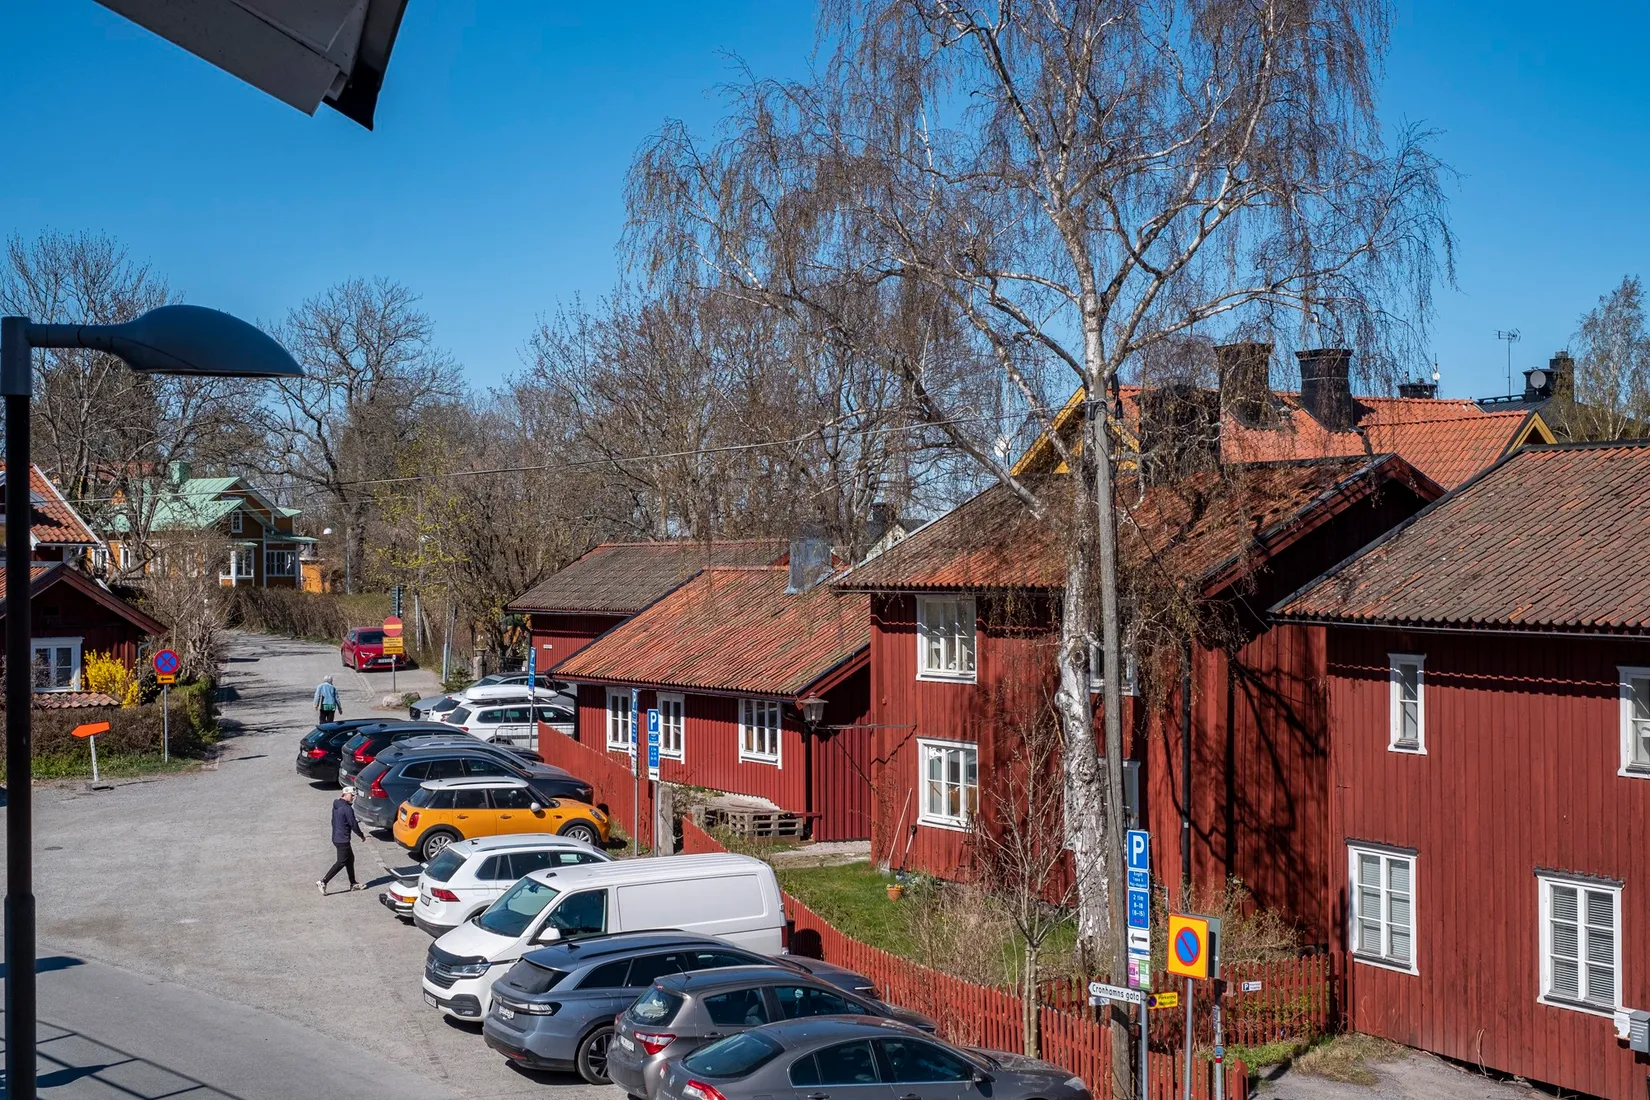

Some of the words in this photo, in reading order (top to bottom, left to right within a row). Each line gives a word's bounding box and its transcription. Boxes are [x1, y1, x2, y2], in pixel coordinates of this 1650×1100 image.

[650, 711, 657, 731] P
[1133, 835, 1145, 866] P
[1092, 984, 1124, 999] Cronhamns
[1125, 992, 1140, 1002] gata
